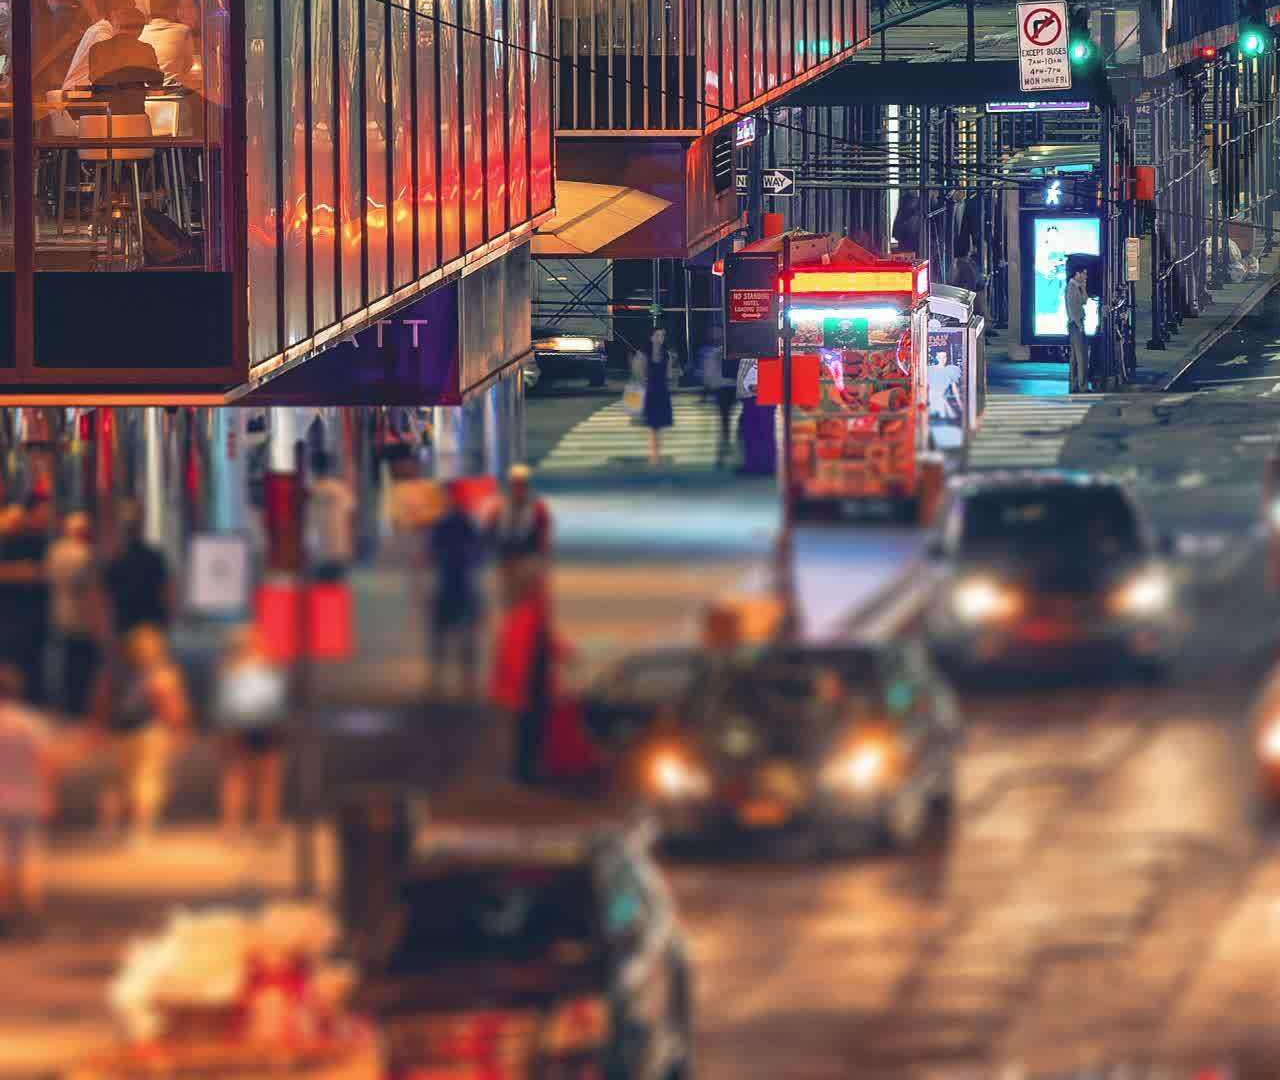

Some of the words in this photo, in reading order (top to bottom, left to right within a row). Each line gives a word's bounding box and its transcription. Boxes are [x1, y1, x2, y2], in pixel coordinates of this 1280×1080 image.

[1022, 48, 1044, 57] EXCEPT
[1046, 47, 1067, 56] BUSES
[1024, 77, 1040, 86] MON
[1056, 76, 1068, 84] FRI
[763, 175, 785, 187] WAY
